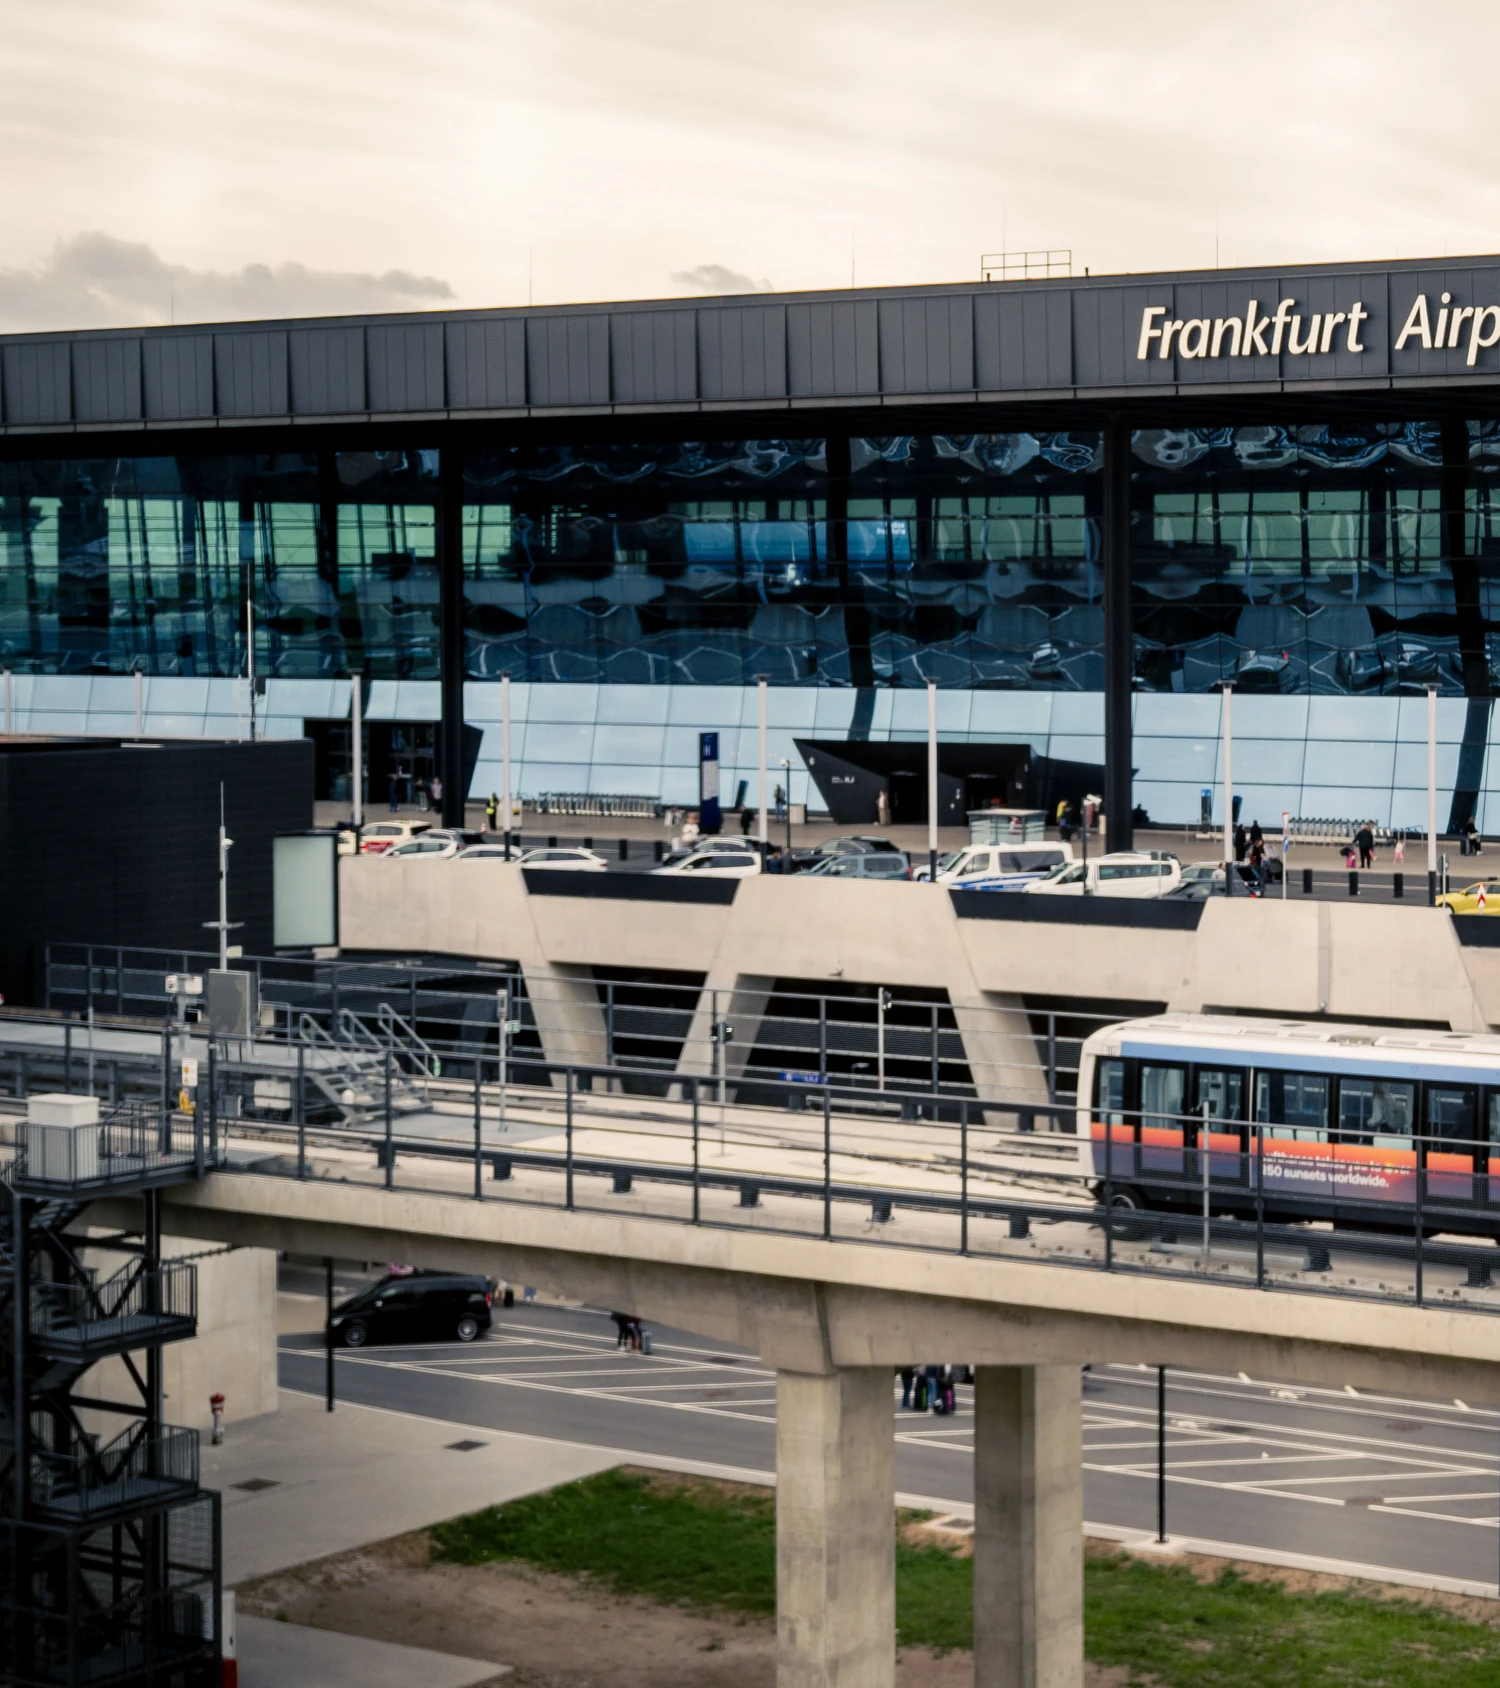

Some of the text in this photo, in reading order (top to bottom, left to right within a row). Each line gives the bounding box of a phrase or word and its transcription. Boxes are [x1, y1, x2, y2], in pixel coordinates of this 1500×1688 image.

[1137, 298, 1367, 360] Frankfurt
[1284, 1167, 1327, 1181] sunsets
[1328, 1173, 1389, 1187] worldwide.
